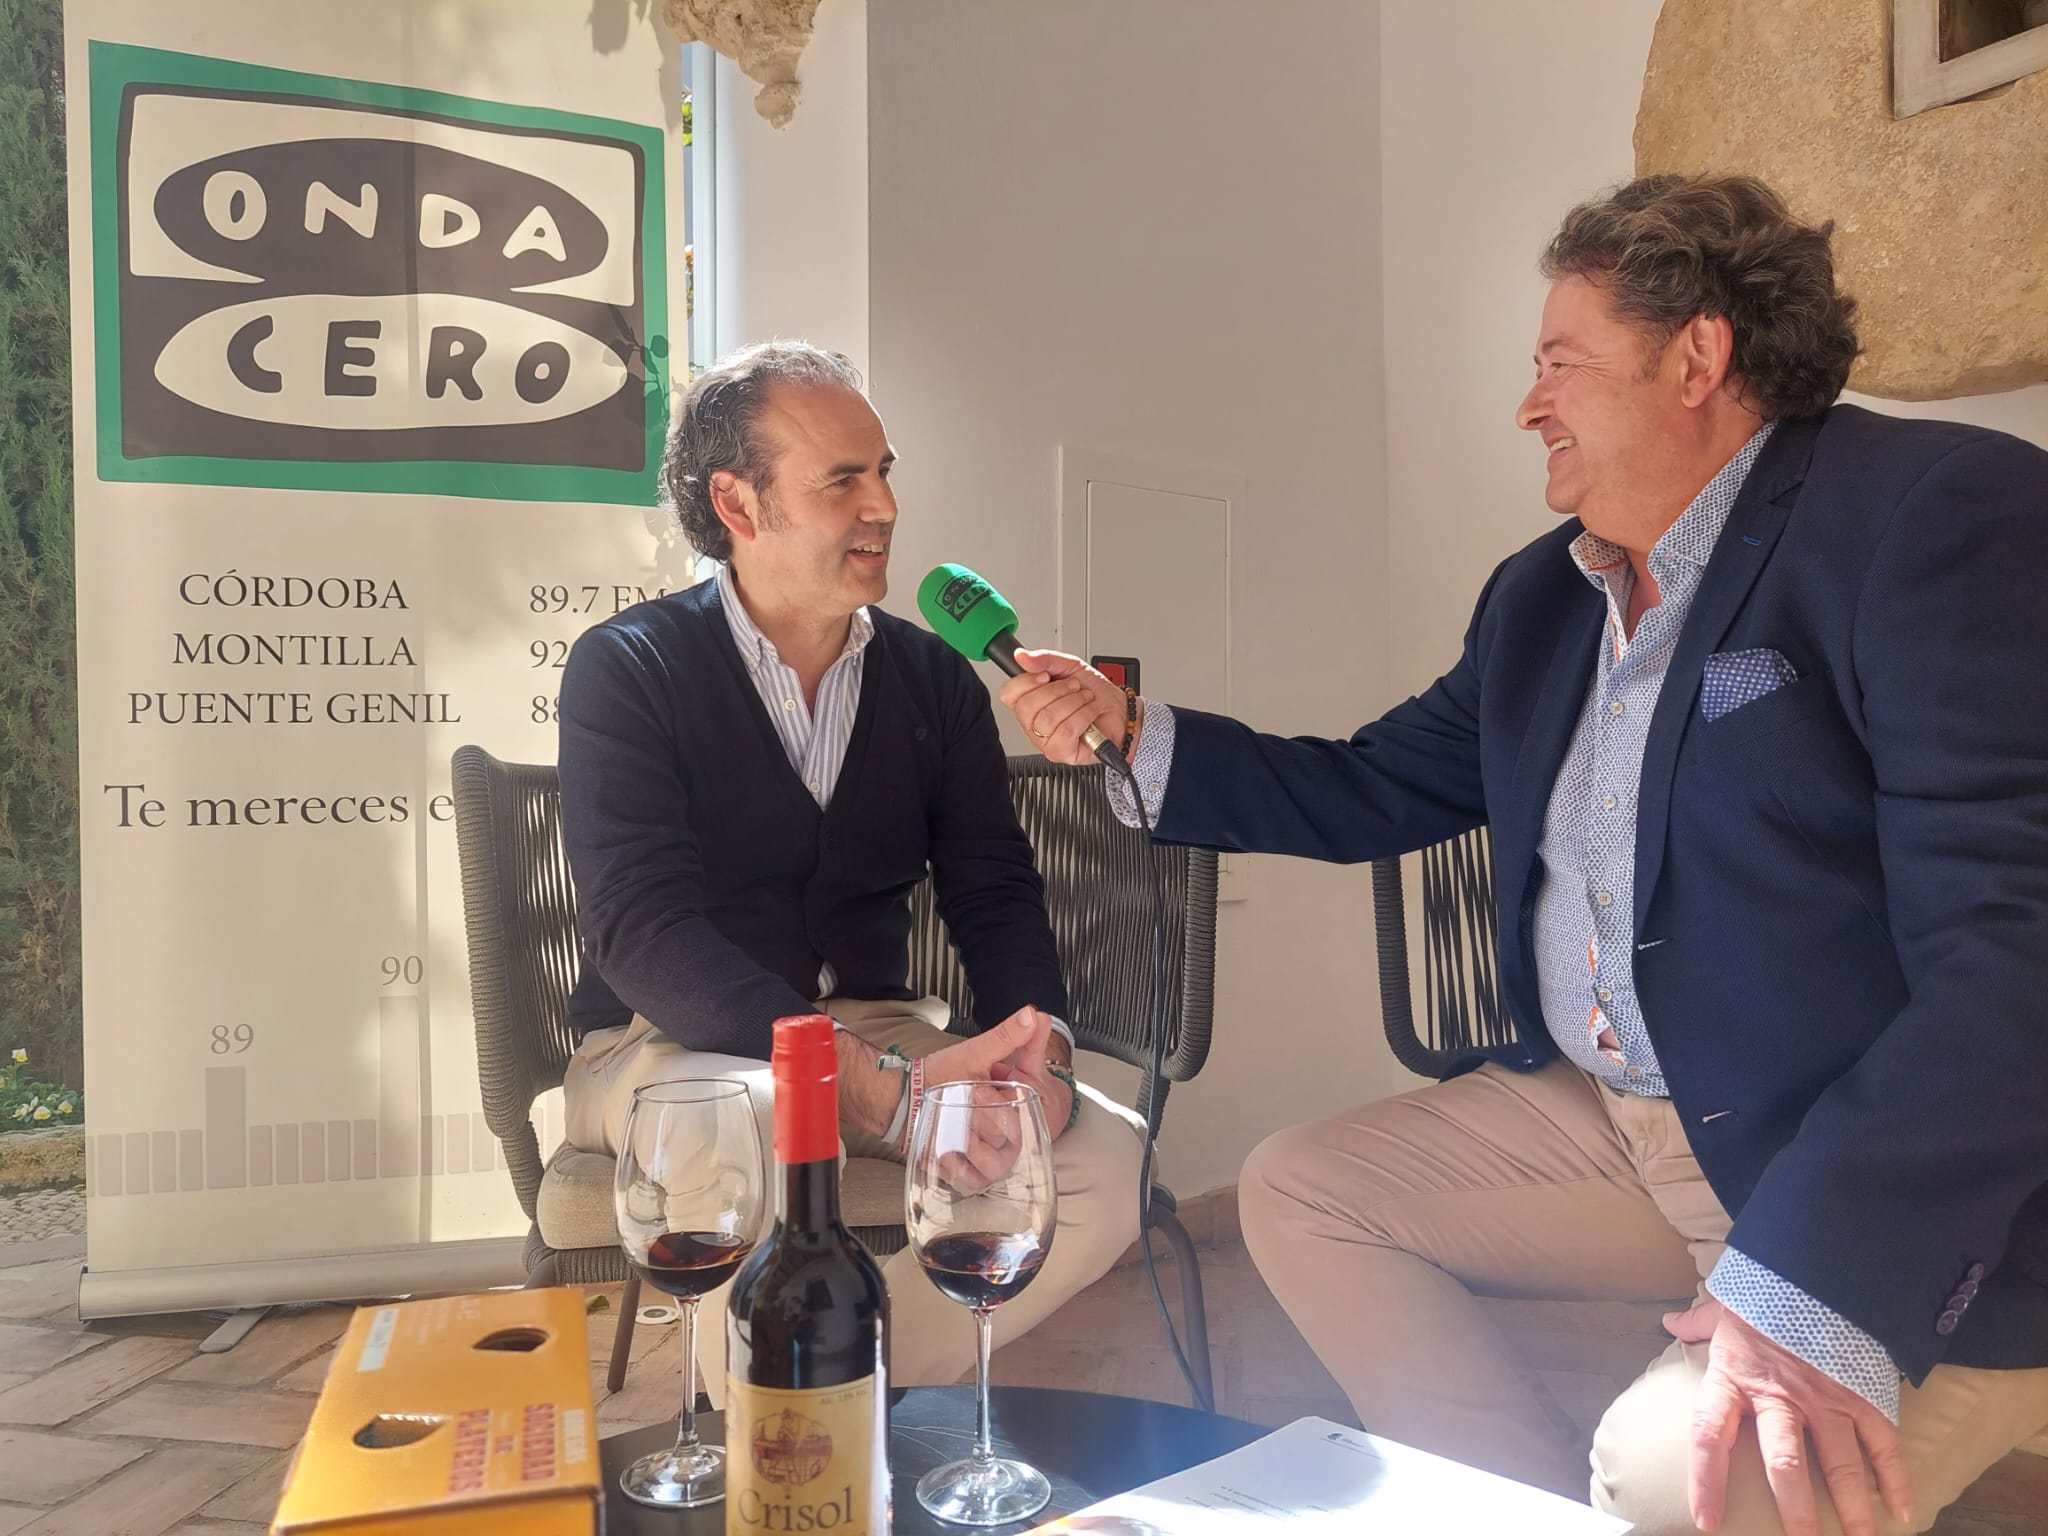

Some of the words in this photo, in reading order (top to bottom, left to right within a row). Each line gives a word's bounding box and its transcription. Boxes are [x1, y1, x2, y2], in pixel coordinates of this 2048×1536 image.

[202, 170, 567, 263] ONDA
[226, 314, 571, 406] CERO
[179, 568, 409, 610] CÓRDOBA
[529, 584, 600, 614] 89.7
[173, 633, 417, 666] MONTILLA
[127, 692, 313, 725] PUENTE
[326, 692, 461, 724] GENIL
[103, 783, 166, 828] Te
[186, 794, 409, 827] mereces
[380, 955, 424, 986] 90
[210, 1023, 255, 1055] 89
[448, 1408, 490, 1494] PLATEROS
[522, 1402, 556, 1482] SOCIEDAD
[738, 1484, 854, 1532] Crisol
